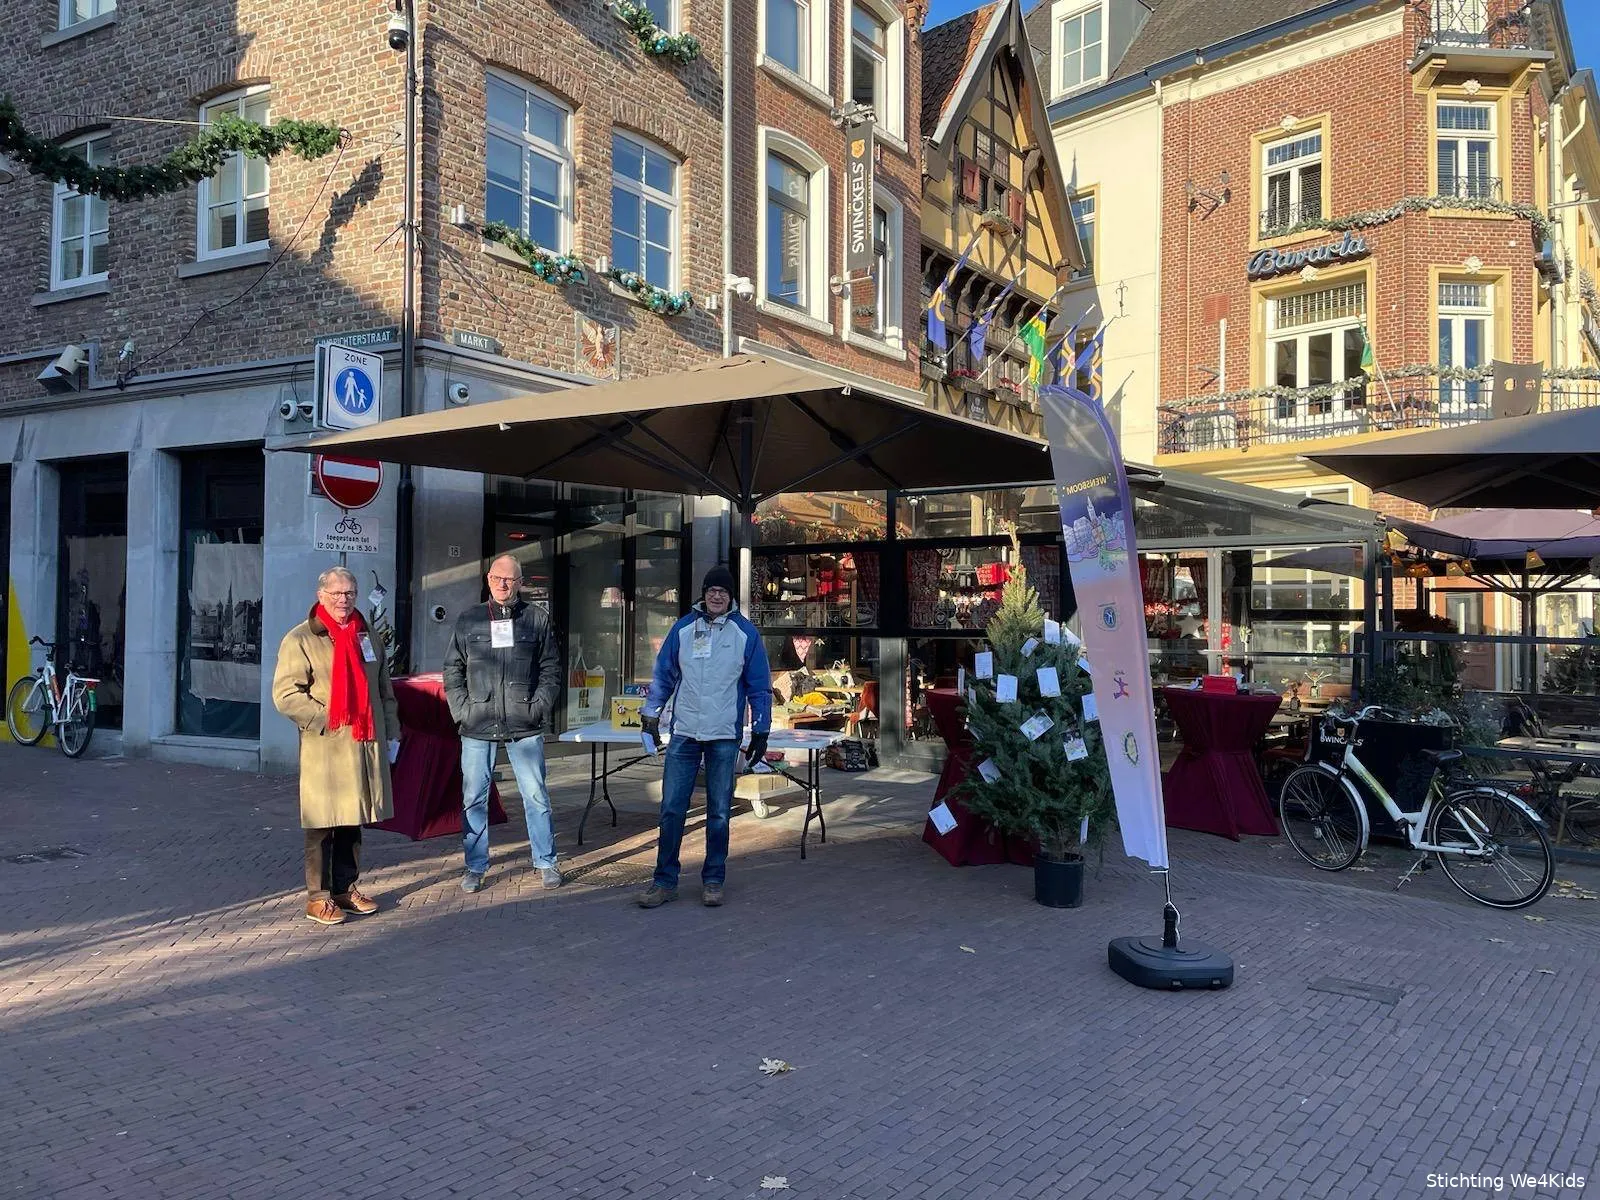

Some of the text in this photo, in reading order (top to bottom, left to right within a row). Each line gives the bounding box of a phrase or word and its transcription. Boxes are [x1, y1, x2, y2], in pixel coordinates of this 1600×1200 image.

[851, 161, 866, 254] SWINCKELS'
[1246, 229, 1369, 277] Bavaria
[460, 333, 489, 349] MARKT
[344, 352, 367, 366] ZONE
